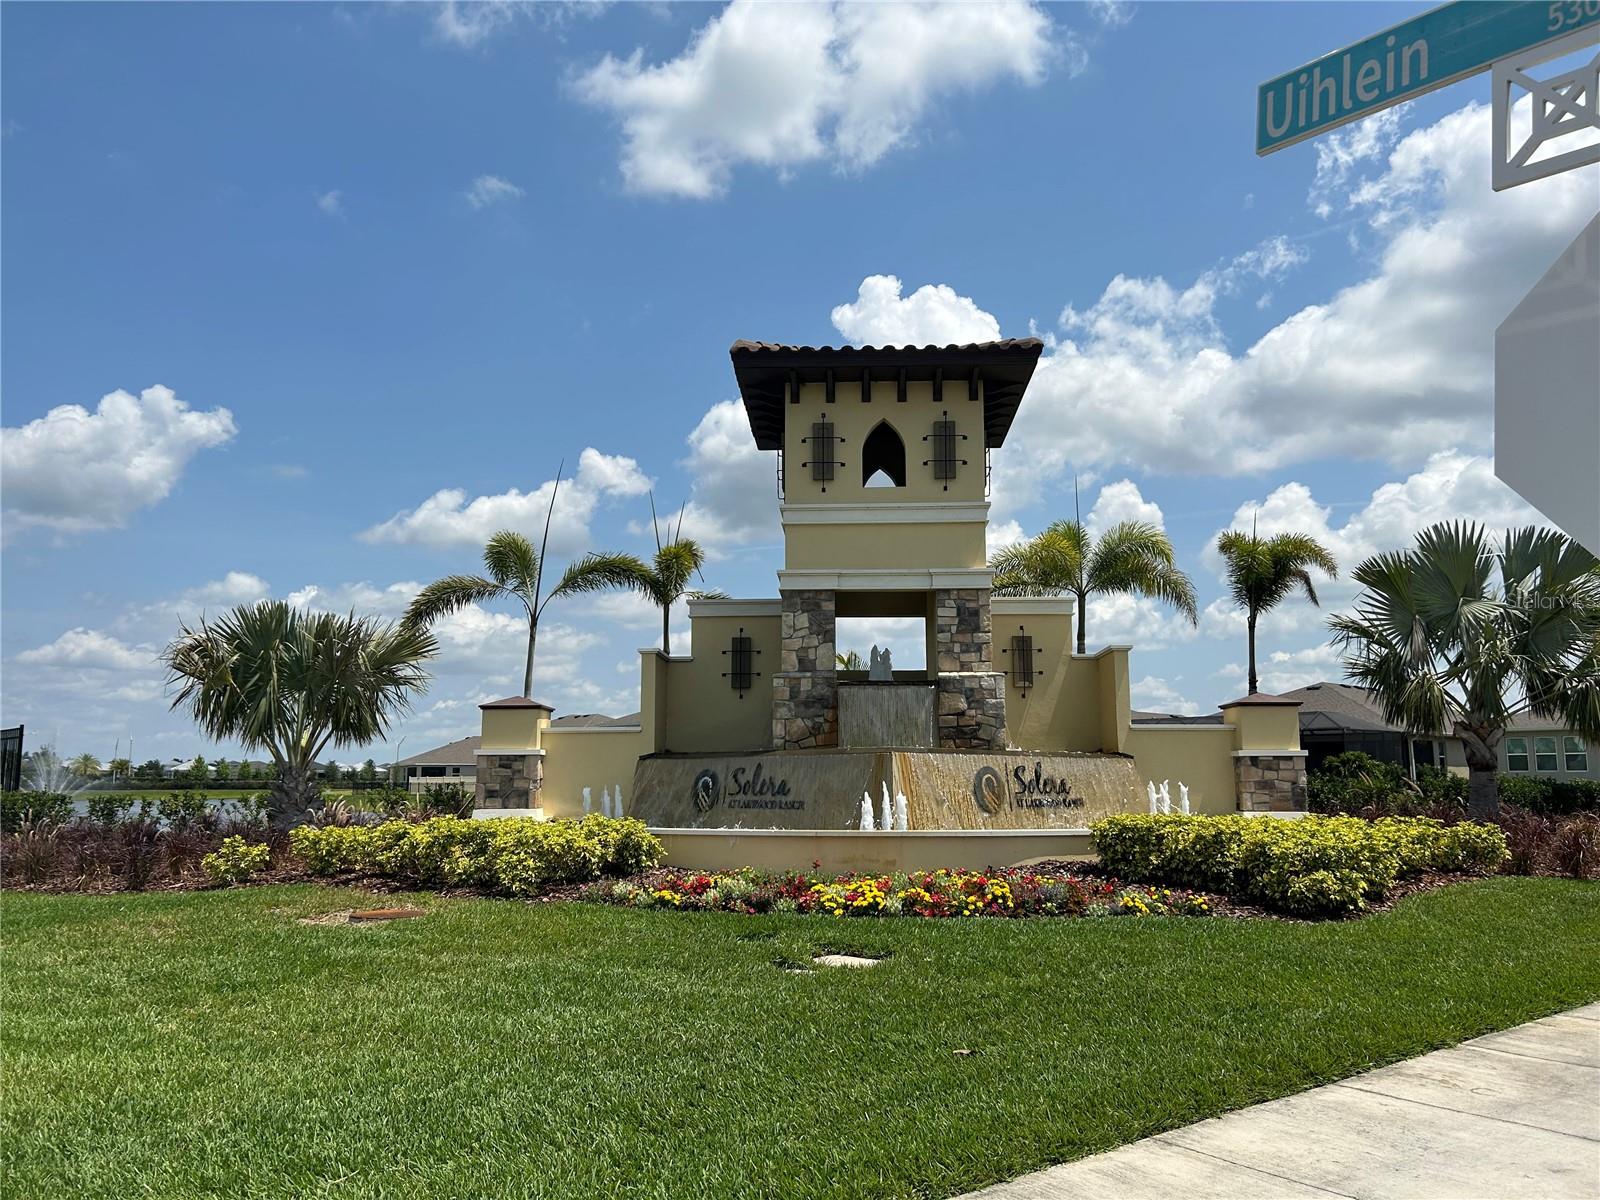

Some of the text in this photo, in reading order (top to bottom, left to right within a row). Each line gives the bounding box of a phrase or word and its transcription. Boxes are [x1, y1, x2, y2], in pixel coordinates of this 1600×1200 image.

[1265, 35, 1429, 138] Uihlein
[728, 762, 791, 796] Solera
[1014, 761, 1072, 795] Solera
